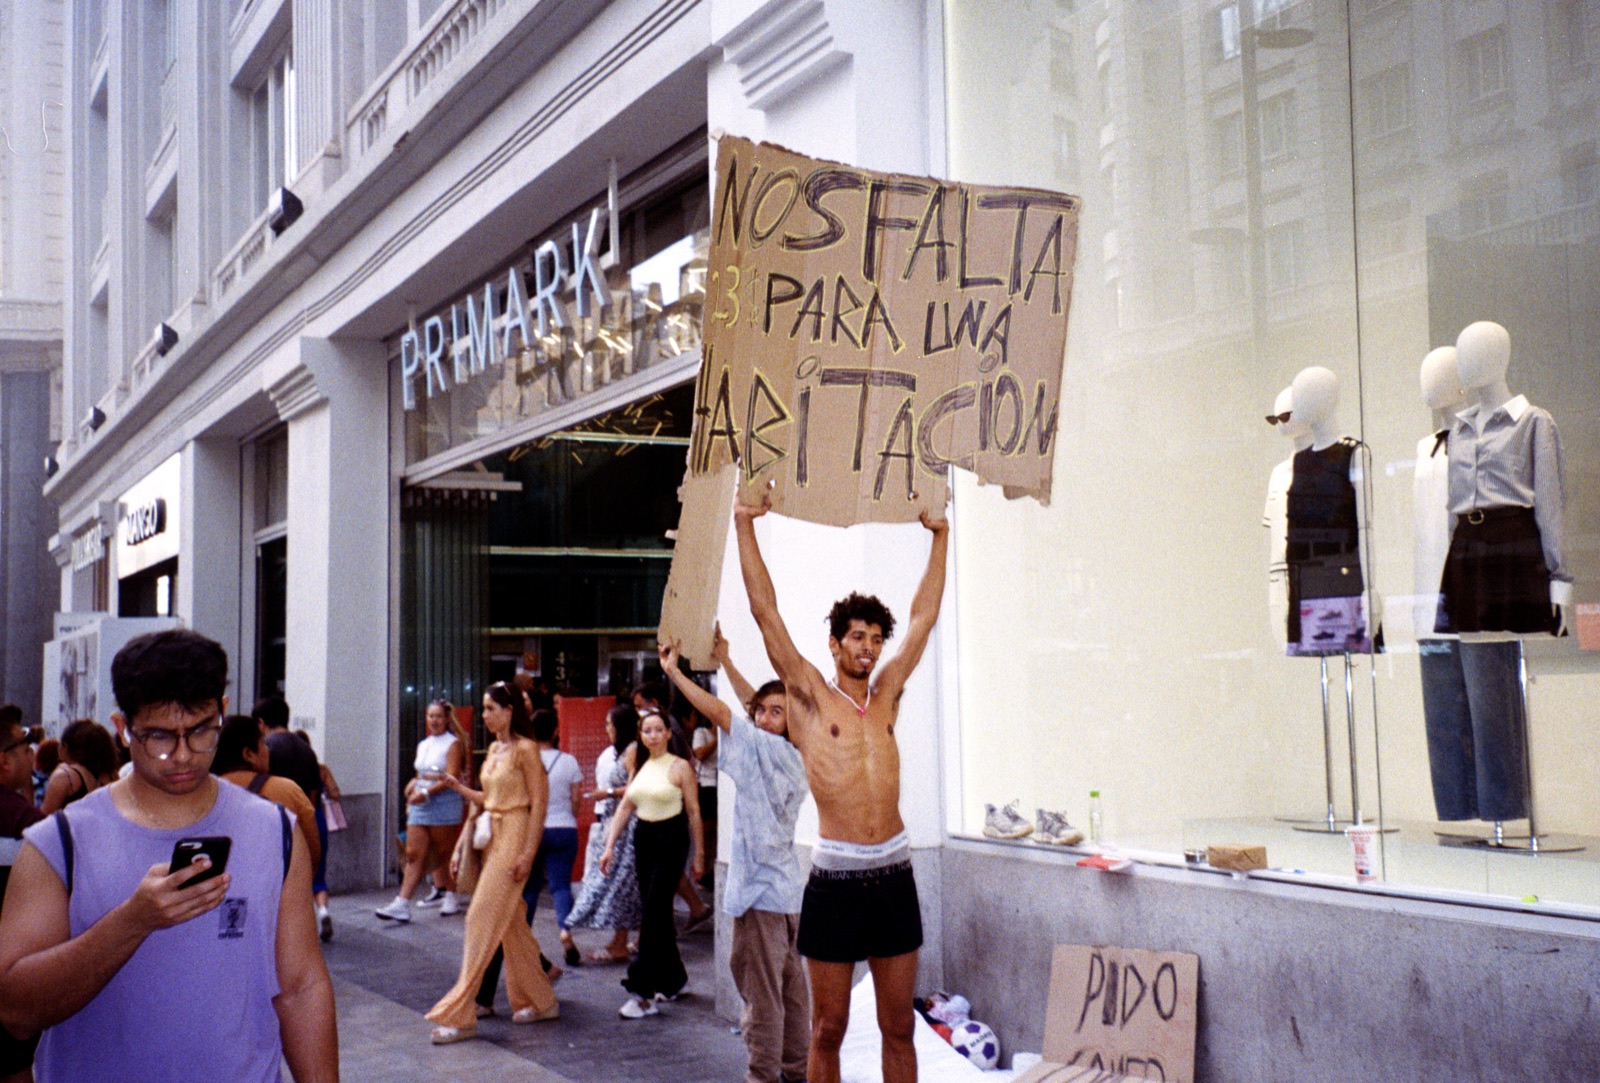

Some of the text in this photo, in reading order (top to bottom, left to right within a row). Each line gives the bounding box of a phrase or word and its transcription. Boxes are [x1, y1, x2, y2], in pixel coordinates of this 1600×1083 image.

[716, 149, 1077, 316] NOS FALTA
[401, 207, 607, 411] PRIMARK
[762, 271, 906, 355] PARA
[923, 297, 1016, 364] UNA
[1075, 953, 1178, 1034] PIDO
